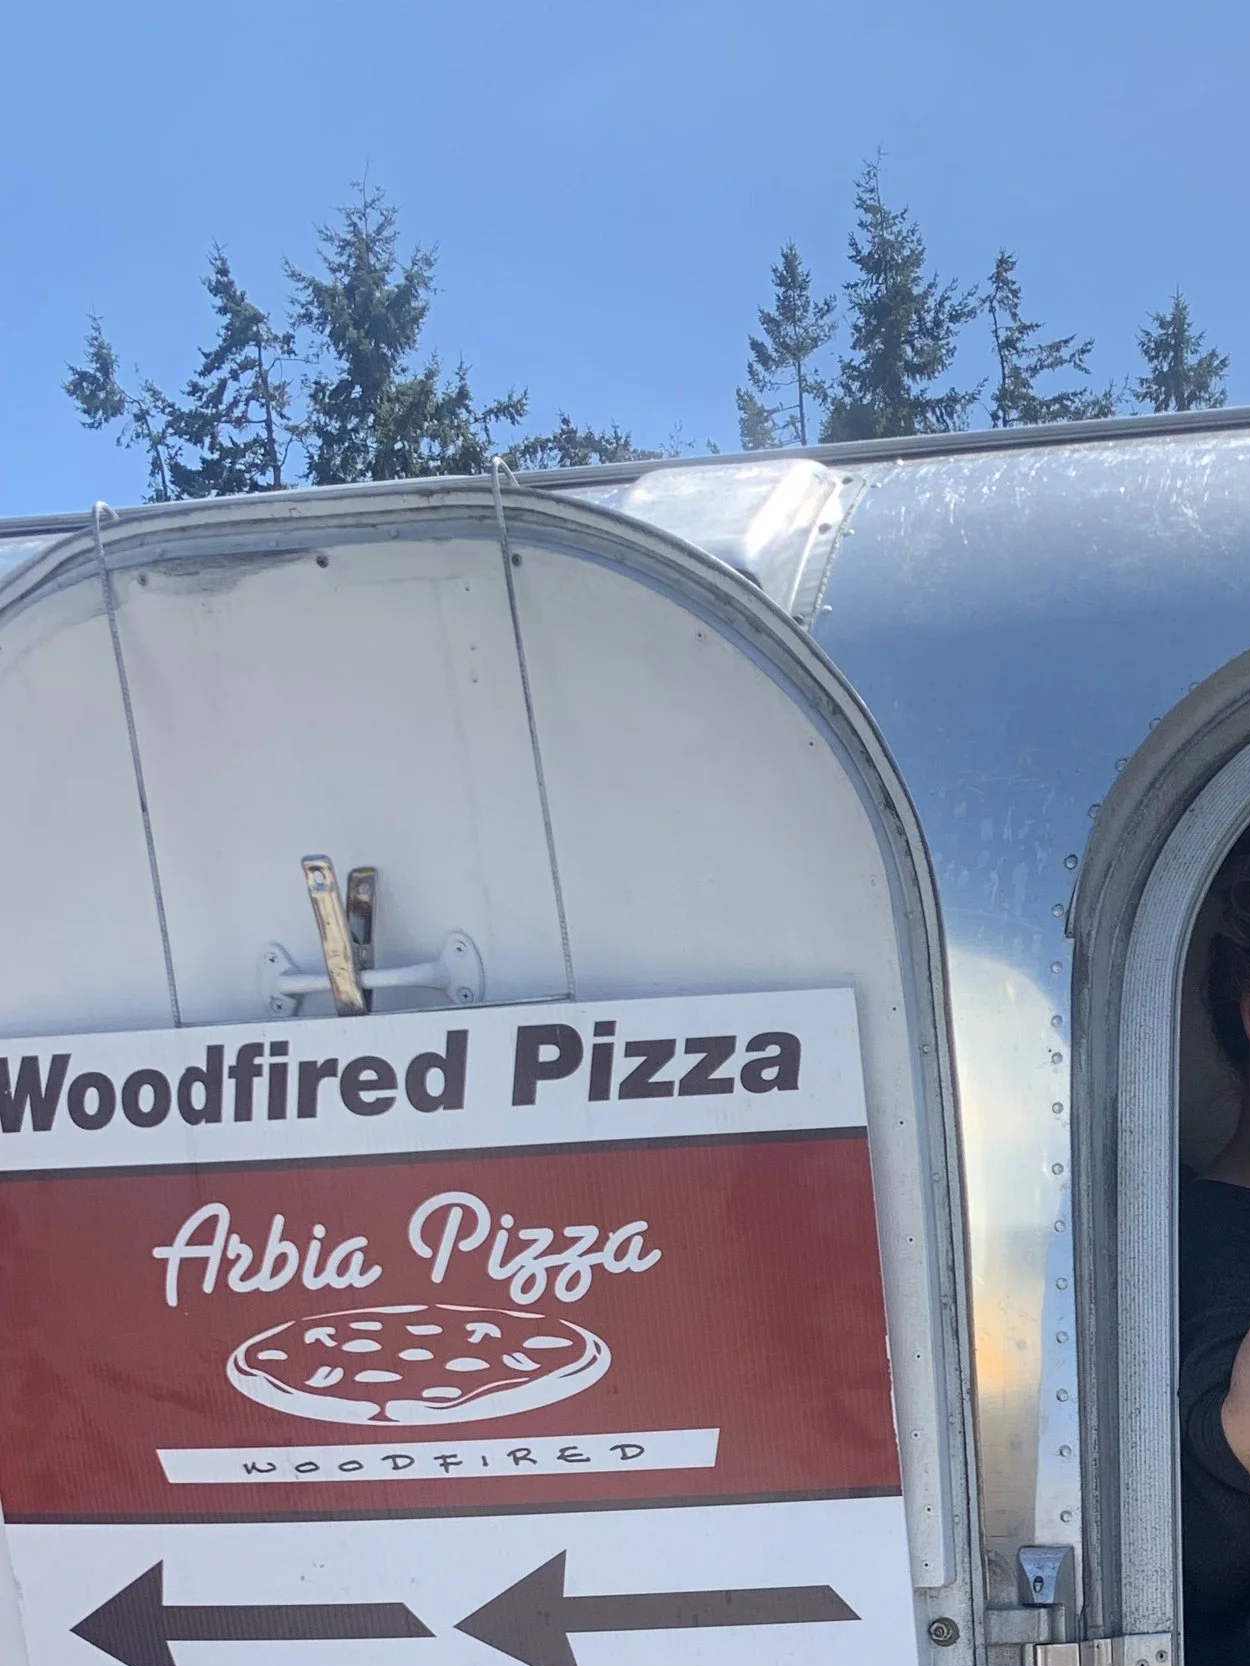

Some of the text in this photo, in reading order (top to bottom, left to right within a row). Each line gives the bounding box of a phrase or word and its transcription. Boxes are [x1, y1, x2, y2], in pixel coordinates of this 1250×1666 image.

[0, 1021, 801, 1133] Woodfired Pizza
[153, 1191, 662, 1306] Arbia Pizza
[243, 1442, 646, 1476] WOODFIRED
